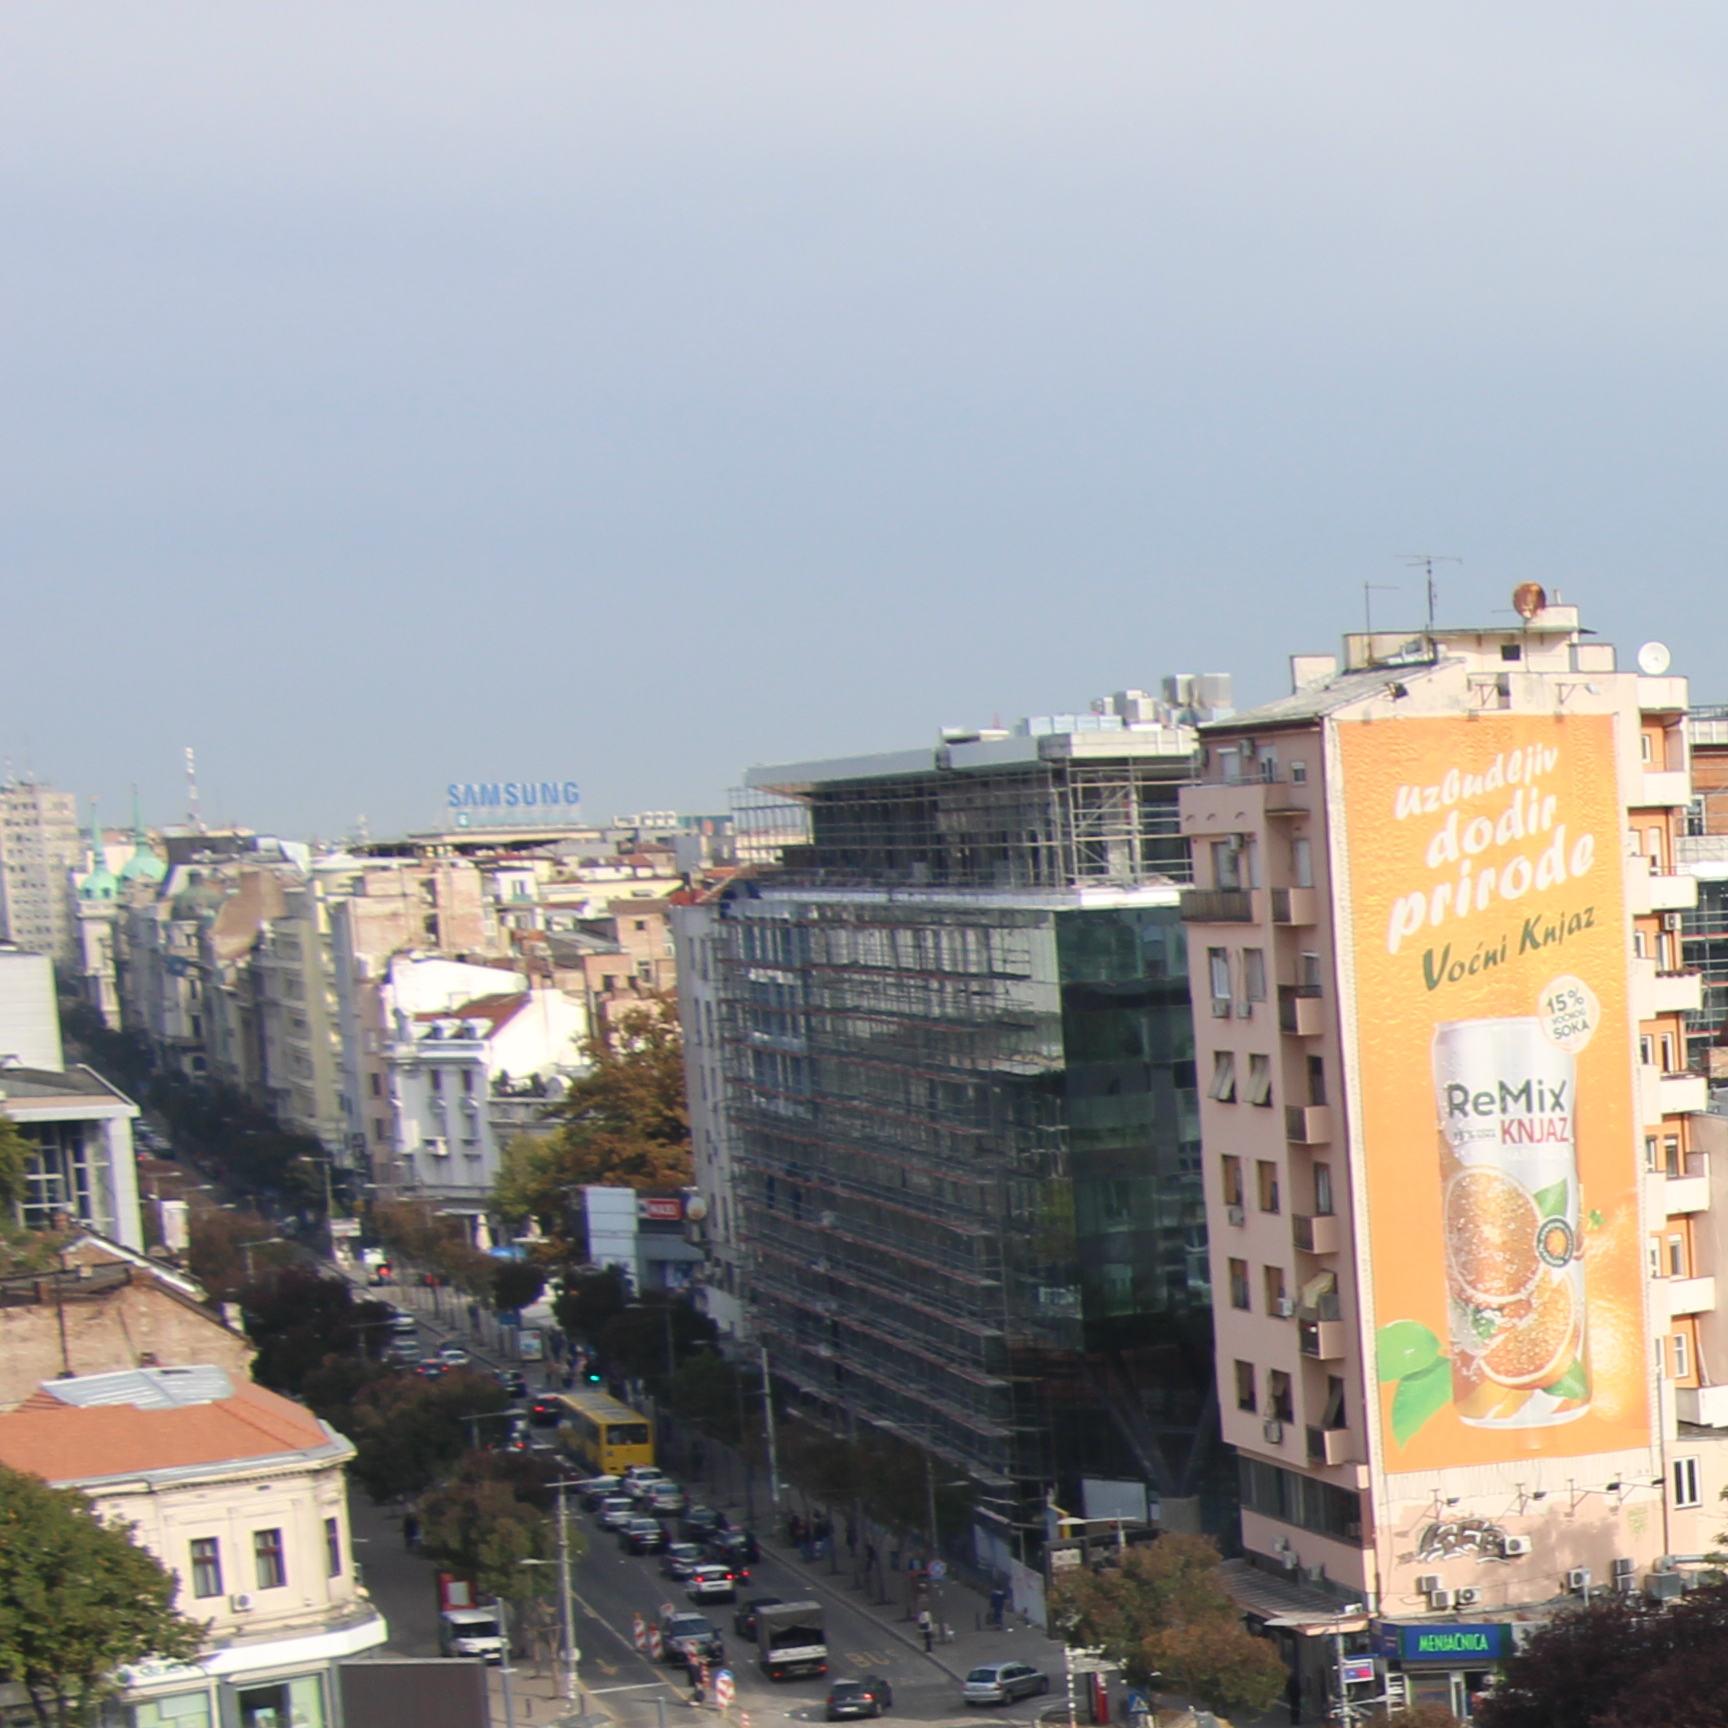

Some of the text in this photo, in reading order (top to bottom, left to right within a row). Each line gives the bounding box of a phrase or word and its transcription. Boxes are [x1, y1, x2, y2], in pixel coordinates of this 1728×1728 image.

[448, 782, 580, 806] SAMSUNG
[1426, 786, 1557, 868] dodir
[1388, 824, 1595, 955] prirode
[1422, 906, 1595, 990] Voćni Knjaz
[1553, 1019, 1590, 1040] SOKA
[1447, 1078, 1567, 1119] ReMix
[1500, 1117, 1569, 1145] KNJAZ
